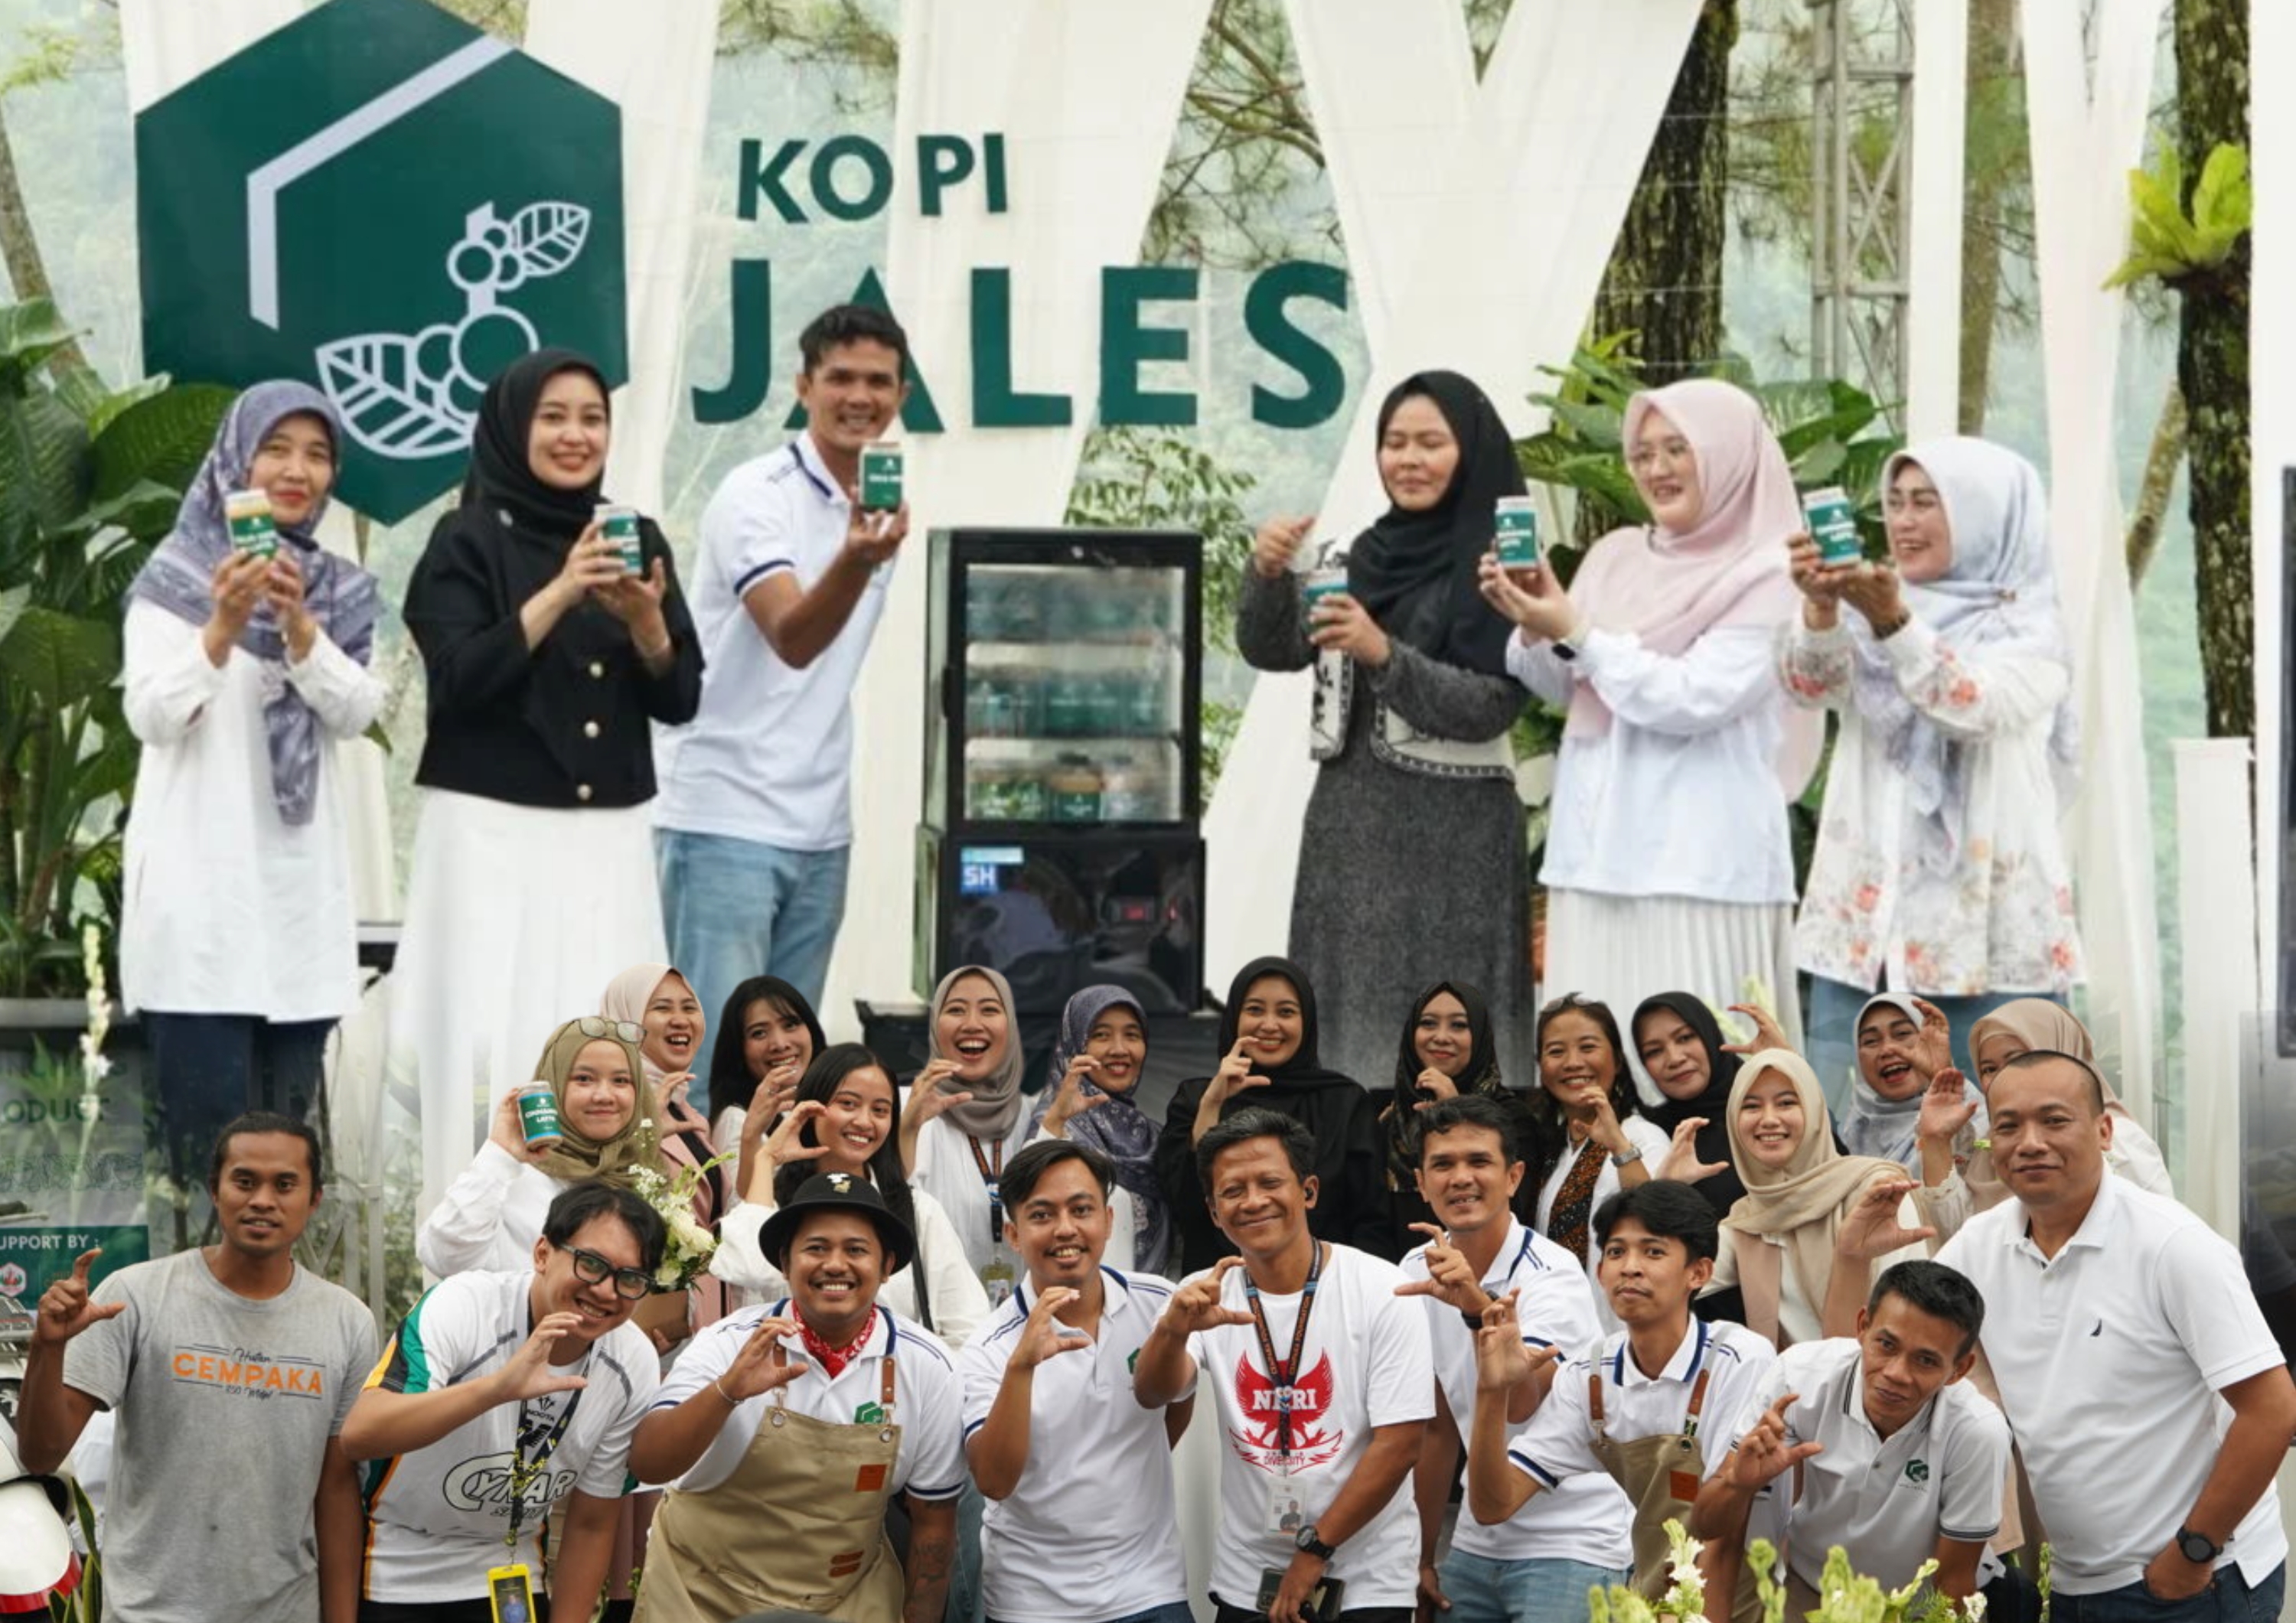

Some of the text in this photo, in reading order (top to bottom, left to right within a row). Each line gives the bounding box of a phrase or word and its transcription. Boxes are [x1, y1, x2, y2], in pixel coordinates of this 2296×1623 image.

[736, 132, 1009, 223] KOPI
[67, 1234, 90, 1249] BY
[171, 1353, 321, 1394] CEMPAKA
